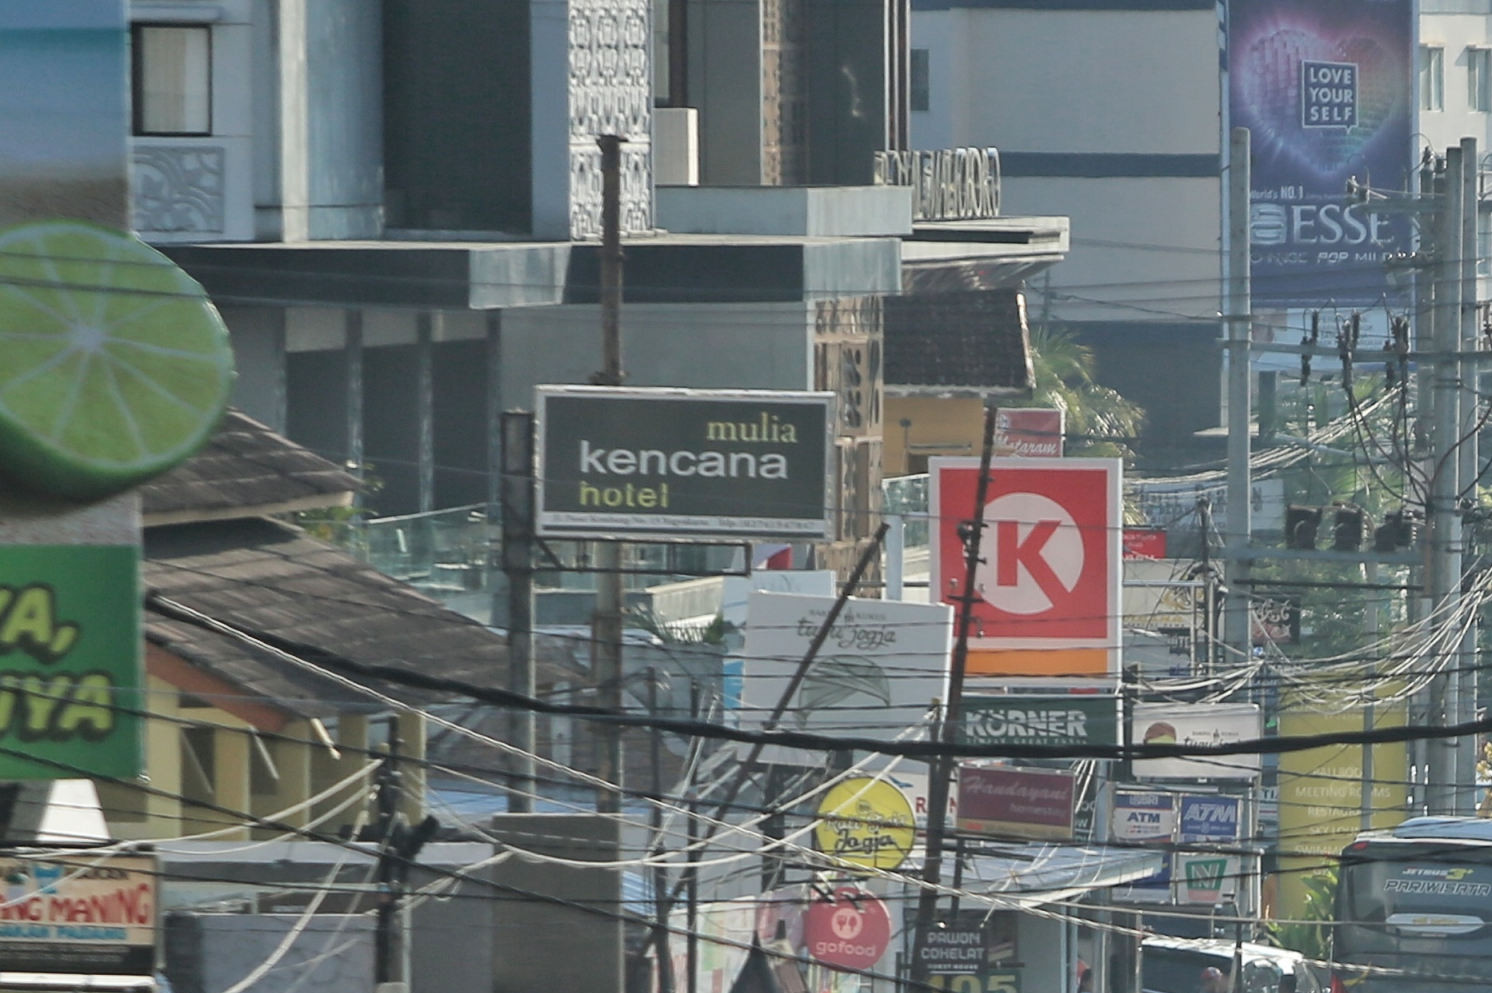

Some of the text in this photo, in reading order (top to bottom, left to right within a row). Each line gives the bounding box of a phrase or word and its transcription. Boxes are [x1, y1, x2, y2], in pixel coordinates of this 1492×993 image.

[1310, 68, 1352, 84] LOVE
[1310, 88, 1353, 103] YOUR
[1310, 106, 1352, 121] SELF
[1291, 203, 1395, 245] ESSE
[706, 412, 798, 443] mulia
[580, 440, 788, 479] kencana
[580, 481, 669, 508] hotel
[997, 520, 1079, 588] K
[962, 775, 1068, 802] Handayani
[1296, 786, 1346, 798] MEETING
[1127, 811, 1160, 824] ATM
[1183, 803, 1236, 823] ATM
[834, 828, 897, 855] Jogja
[1384, 879, 1492, 897] PARIWISATA
[927, 931, 981, 945] PAWON
[815, 940, 876, 957] gofood
[920, 947, 985, 960] COKELAT
